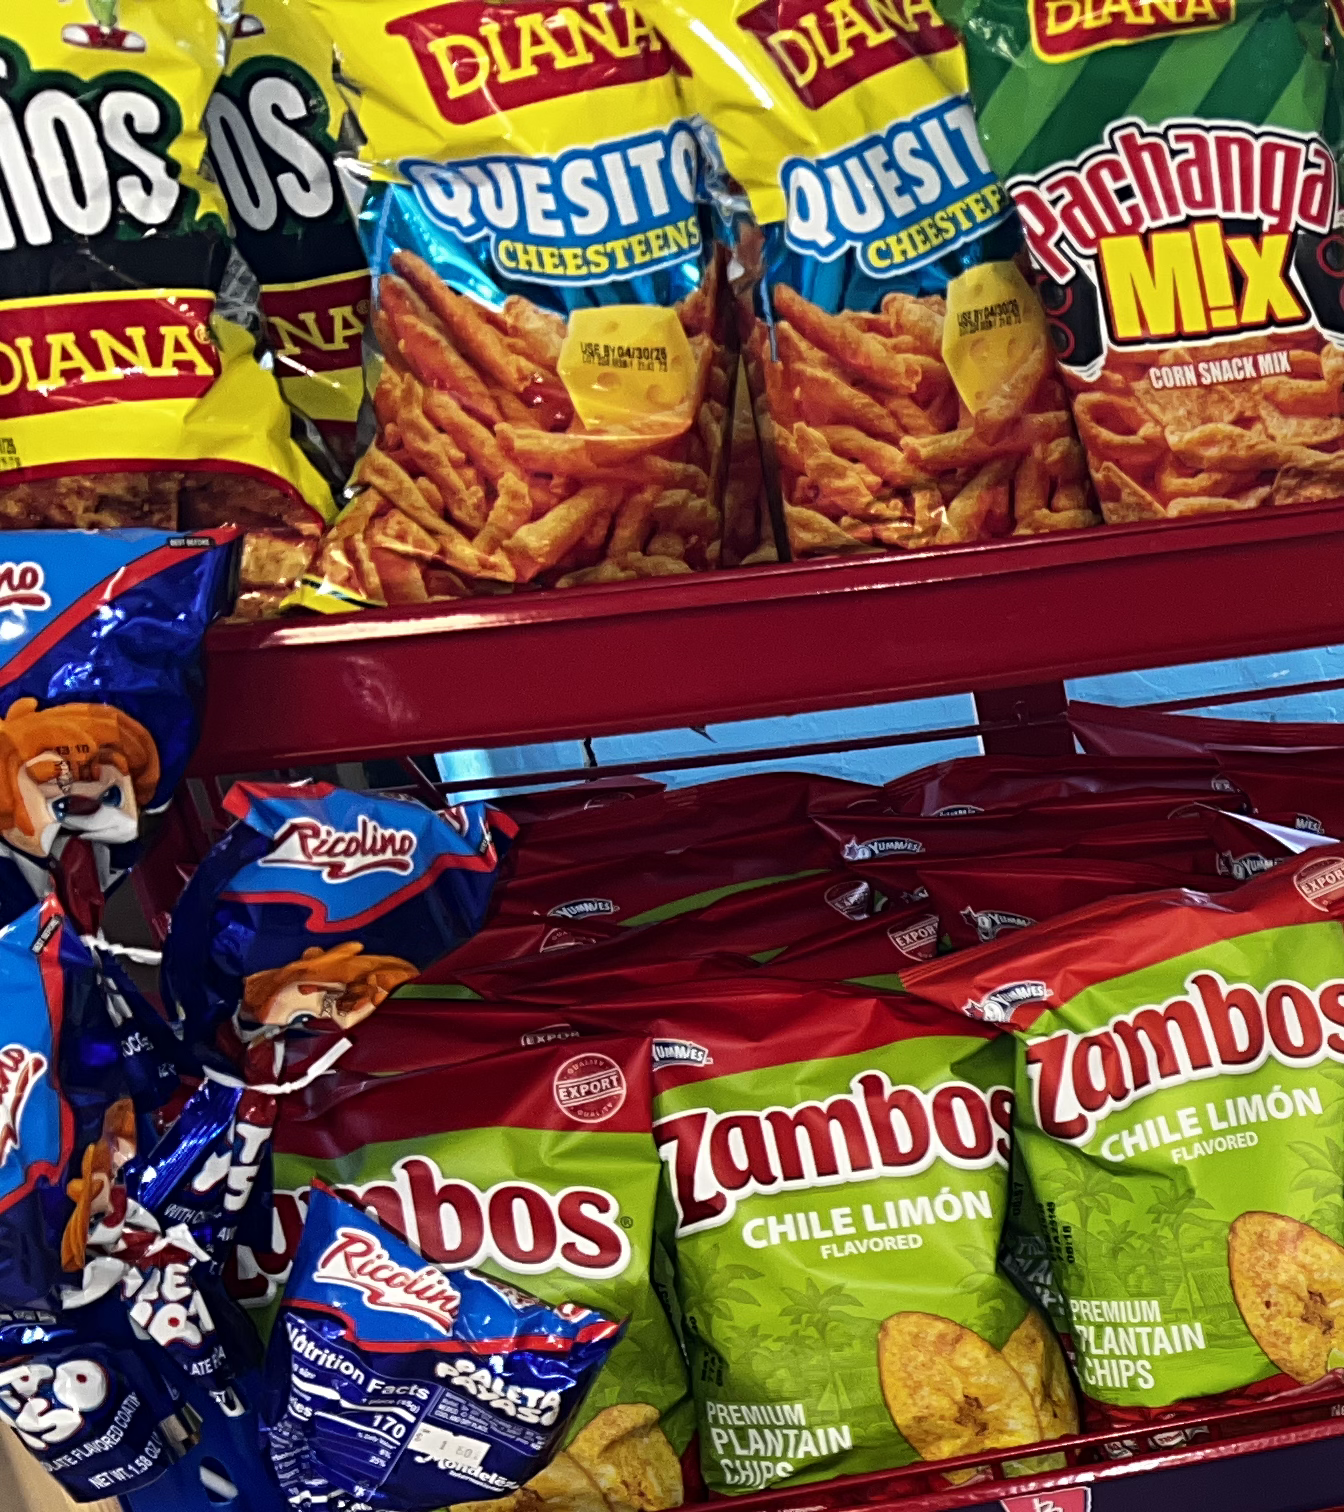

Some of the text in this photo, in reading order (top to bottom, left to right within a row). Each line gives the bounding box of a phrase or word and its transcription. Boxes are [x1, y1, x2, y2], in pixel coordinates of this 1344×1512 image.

[428, 0, 664, 100] DIANA
[769, 0, 944, 87] DIANA
[1012, 128, 1336, 280] Pachanga
[499, 218, 698, 277] CHEESTEENS
[1149, 353, 1291, 390] CORN SNACK MIX
[559, 1073, 621, 1102] EXPORT
[1101, 1085, 1324, 1162] CHILE LIMÓN
[1171, 1130, 1259, 1165] FLAVORED
[742, 1186, 993, 1250] CHILE LIMÓN
[821, 1234, 923, 1260] FLAVORED
[1070, 1300, 1161, 1323] PREMIUM
[1077, 1324, 1206, 1357] PLANTAIN
[367, 1378, 430, 1401] Facts
[1084, 1360, 1155, 1389] CHIPS
[373, 1414, 406, 1440] 170
[707, 1402, 806, 1428] PREMIUM
[711, 1425, 852, 1457] PLANTAIN
[89, 1473, 115, 1489] NET
[128, 1453, 152, 1476] 1.58
[725, 1457, 796, 1486] CHIPS
